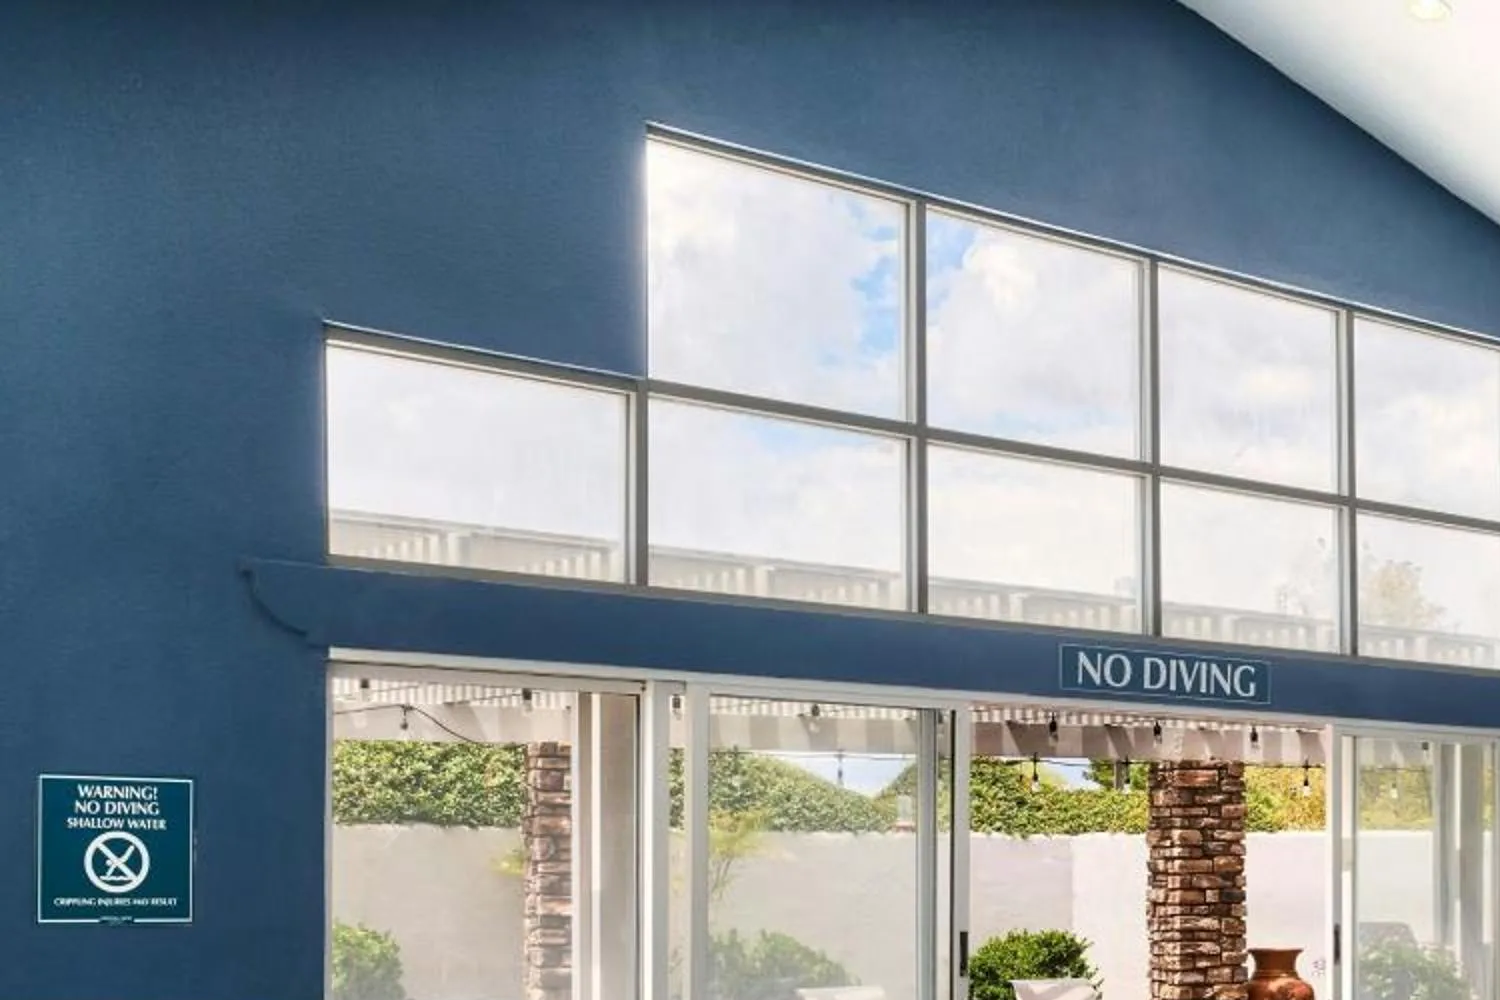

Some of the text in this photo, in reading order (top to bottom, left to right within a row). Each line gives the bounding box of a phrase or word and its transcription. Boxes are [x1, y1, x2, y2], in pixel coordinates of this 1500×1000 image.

[1077, 651, 1257, 697] NO DIVING
[77, 784, 158, 800] WARNING!
[74, 801, 160, 815] NO DIVING
[66, 818, 167, 830] SHALLOW WATER
